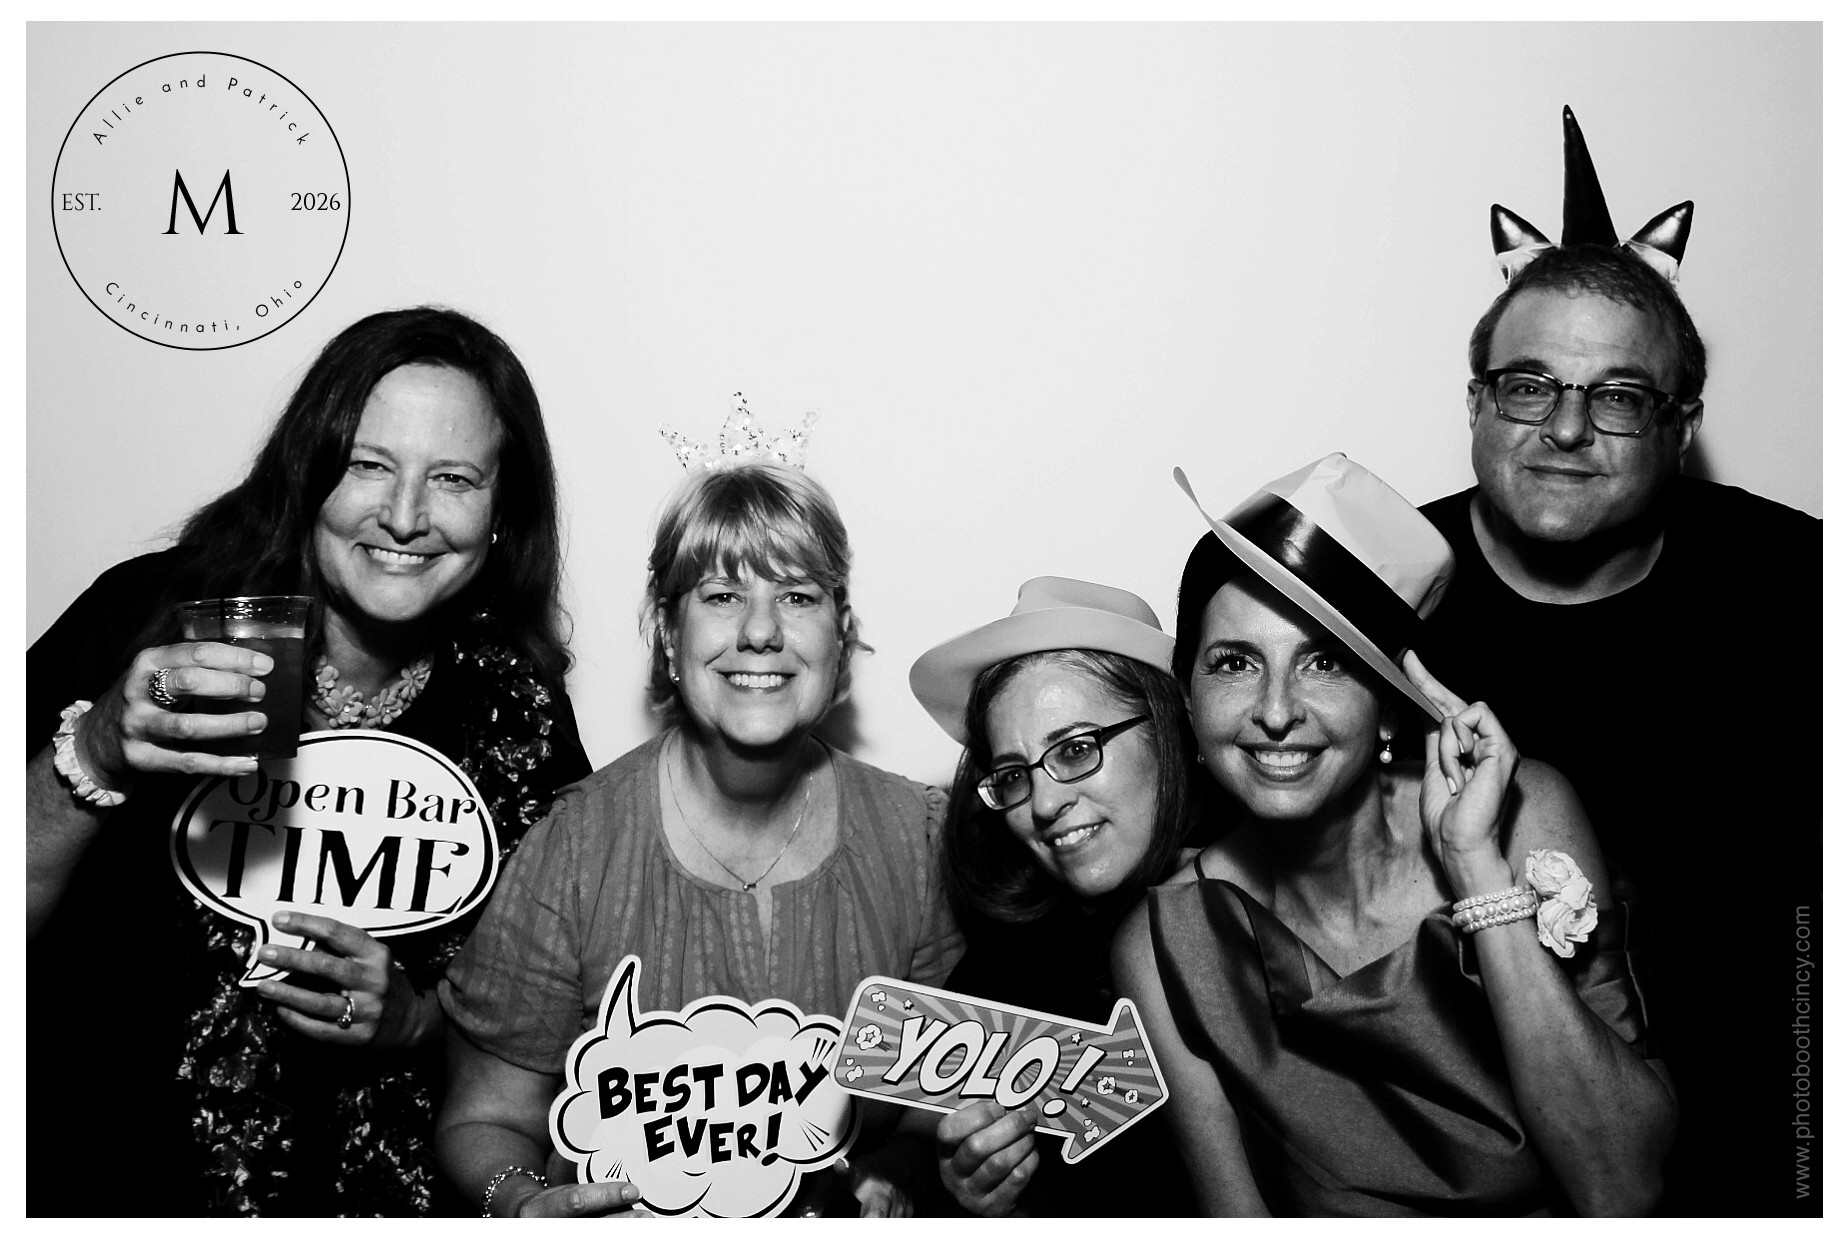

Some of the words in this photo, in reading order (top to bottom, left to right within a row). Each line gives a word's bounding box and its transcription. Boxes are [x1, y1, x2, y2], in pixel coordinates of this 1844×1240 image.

[228, 766, 364, 822] Open
[386, 778, 477, 824] Bar
[208, 819, 470, 913] TIME
[597, 1063, 724, 1120] BEST
[735, 1060, 829, 1107] DAY
[881, 1015, 1107, 1118] YOLO!
[643, 1111, 783, 1167] EVER!
